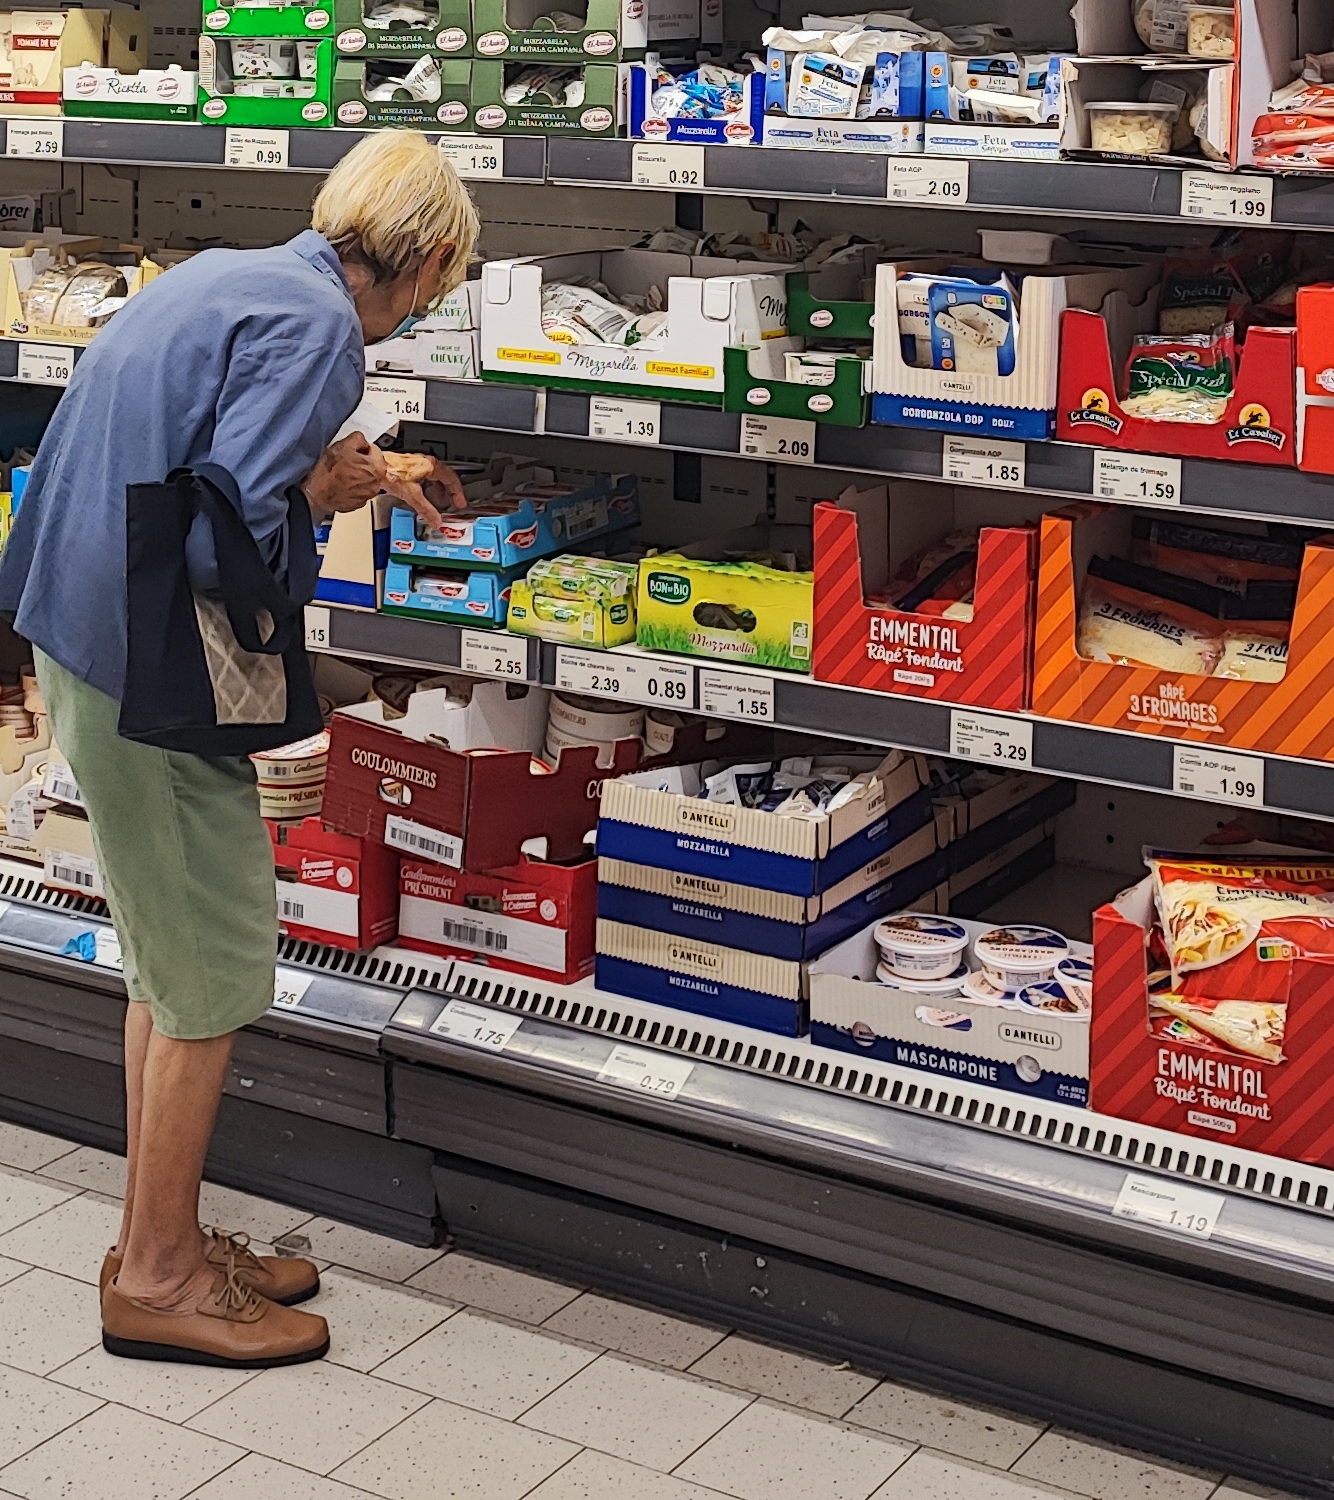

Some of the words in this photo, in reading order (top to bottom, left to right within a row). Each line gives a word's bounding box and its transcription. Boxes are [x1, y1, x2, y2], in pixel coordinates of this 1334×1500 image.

[35, 141, 58, 154] 2.59
[257, 150, 281, 164] 0.99
[470, 155, 497, 171] 1.59
[670, 169, 697, 185] 0.92
[929, 181, 960, 197] 2.09
[1230, 200, 1265, 216] 1.99
[46, 366, 67, 379] 3.09
[394, 401, 420, 415] 1.64
[626, 421, 654, 436] 1.39
[778, 441, 809, 458] 2.09
[986, 463, 1020, 481] 1.85
[1139, 483, 1174, 498] 1.59
[869, 617, 961, 653] EMMENTAL
[494, 656, 522, 675] 2.55
[867, 641, 905, 665] Râpé
[905, 647, 964, 674] Fondant
[591, 674, 620, 693] 2.39
[647, 678, 687, 700] 0.89
[1160, 684, 1185, 700] RÂPÉ
[737, 698, 767, 716] 1.55
[1130, 694, 1139, 713] 3
[1142, 697, 1218, 724] FROMAGES
[993, 740, 1026, 760] 3.29
[352, 748, 437, 789] COULOMMIERS
[1221, 777, 1255, 798] 1.99
[676, 839, 730, 857] MOZZARELLA
[404, 881, 452, 900] PRÉSIDENT
[672, 903, 722, 921] MOZZARELLA
[472, 1026, 505, 1045] 1.75
[896, 1046, 998, 1082] MASCARPONE
[1158, 1049, 1266, 1098] EMMENTAL
[640, 1074, 676, 1094] 0.79
[1154, 1077, 1198, 1104] Râpé
[1201, 1088, 1270, 1121] Fondant
[1168, 1209, 1208, 1232] 1.19
